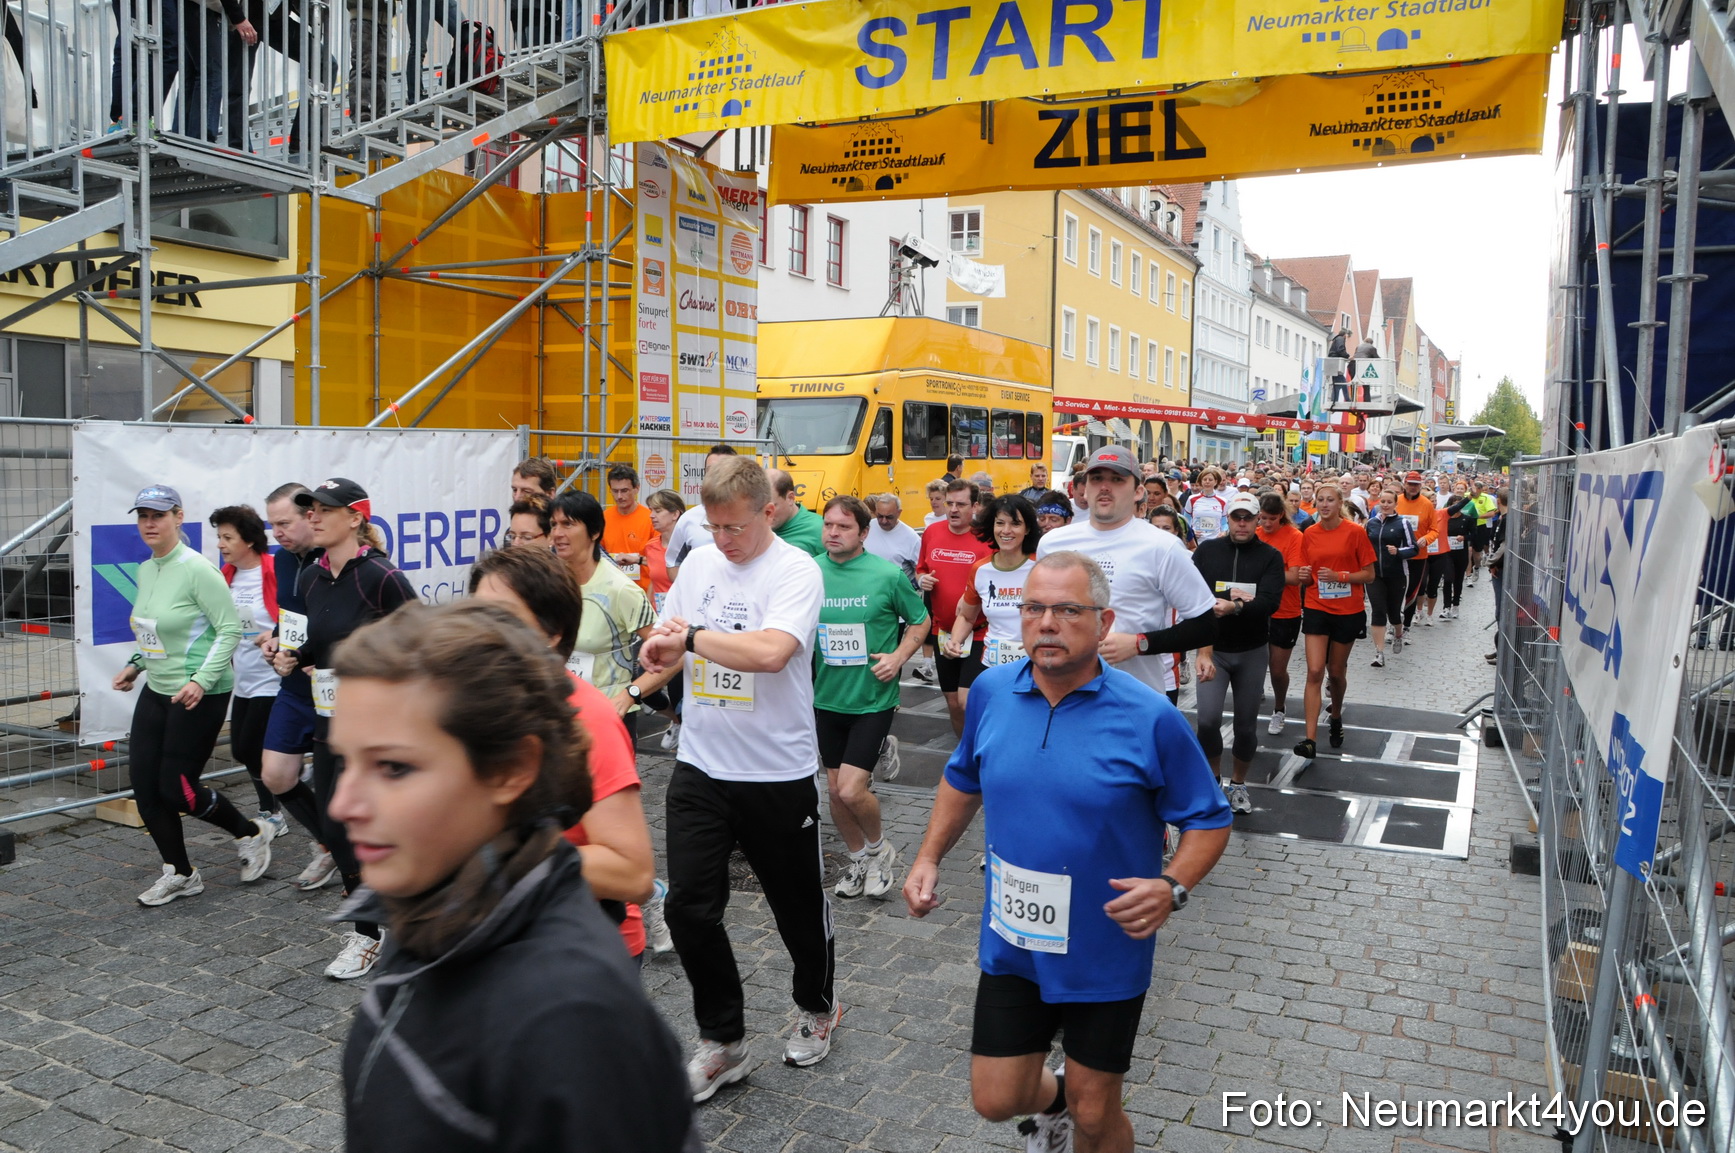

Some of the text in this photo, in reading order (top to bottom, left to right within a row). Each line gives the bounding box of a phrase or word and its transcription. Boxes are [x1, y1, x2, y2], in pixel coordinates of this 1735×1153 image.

[1246, 4, 1379, 32] Neumarkter
[854, 0, 1168, 89] START
[639, 70, 806, 105] Neumarkter Stadtlauf
[1309, 104, 1502, 137] Neumarkter Stadtlauf
[1033, 98, 1206, 169] ZIEL
[800, 152, 946, 175] Neumarkter Stadtlauf
[717, 185, 759, 206] MERZ
[730, 249, 754, 261] WITTMANN
[69, 259, 202, 308] WEBER
[638, 302, 669, 318] Sinupret
[725, 299, 758, 320] OBI
[638, 317, 657, 330] forte
[647, 341, 670, 352] Egner
[789, 382, 845, 394] TIMING
[926, 379, 956, 391] SPORTRONIC
[1001, 389, 1031, 402] EVENT SERVICE
[1065, 400, 1090, 409] Service
[1181, 410, 1198, 418] 6352
[640, 422, 671, 432] HACKNER
[683, 464, 706, 481] Sinup
[684, 481, 702, 495] fort
[998, 587, 1023, 596] MER
[1327, 582, 1348, 590] 2742
[284, 628, 306, 644] 184
[828, 627, 853, 636] Reinhold
[142, 633, 157, 645] 183
[829, 639, 860, 651] 2310
[1000, 643, 1012, 651] Elke
[713, 671, 742, 691] 152
[321, 688, 336, 702] 18
[1003, 871, 1039, 893] Jürgen
[1004, 894, 1056, 925] 3390
